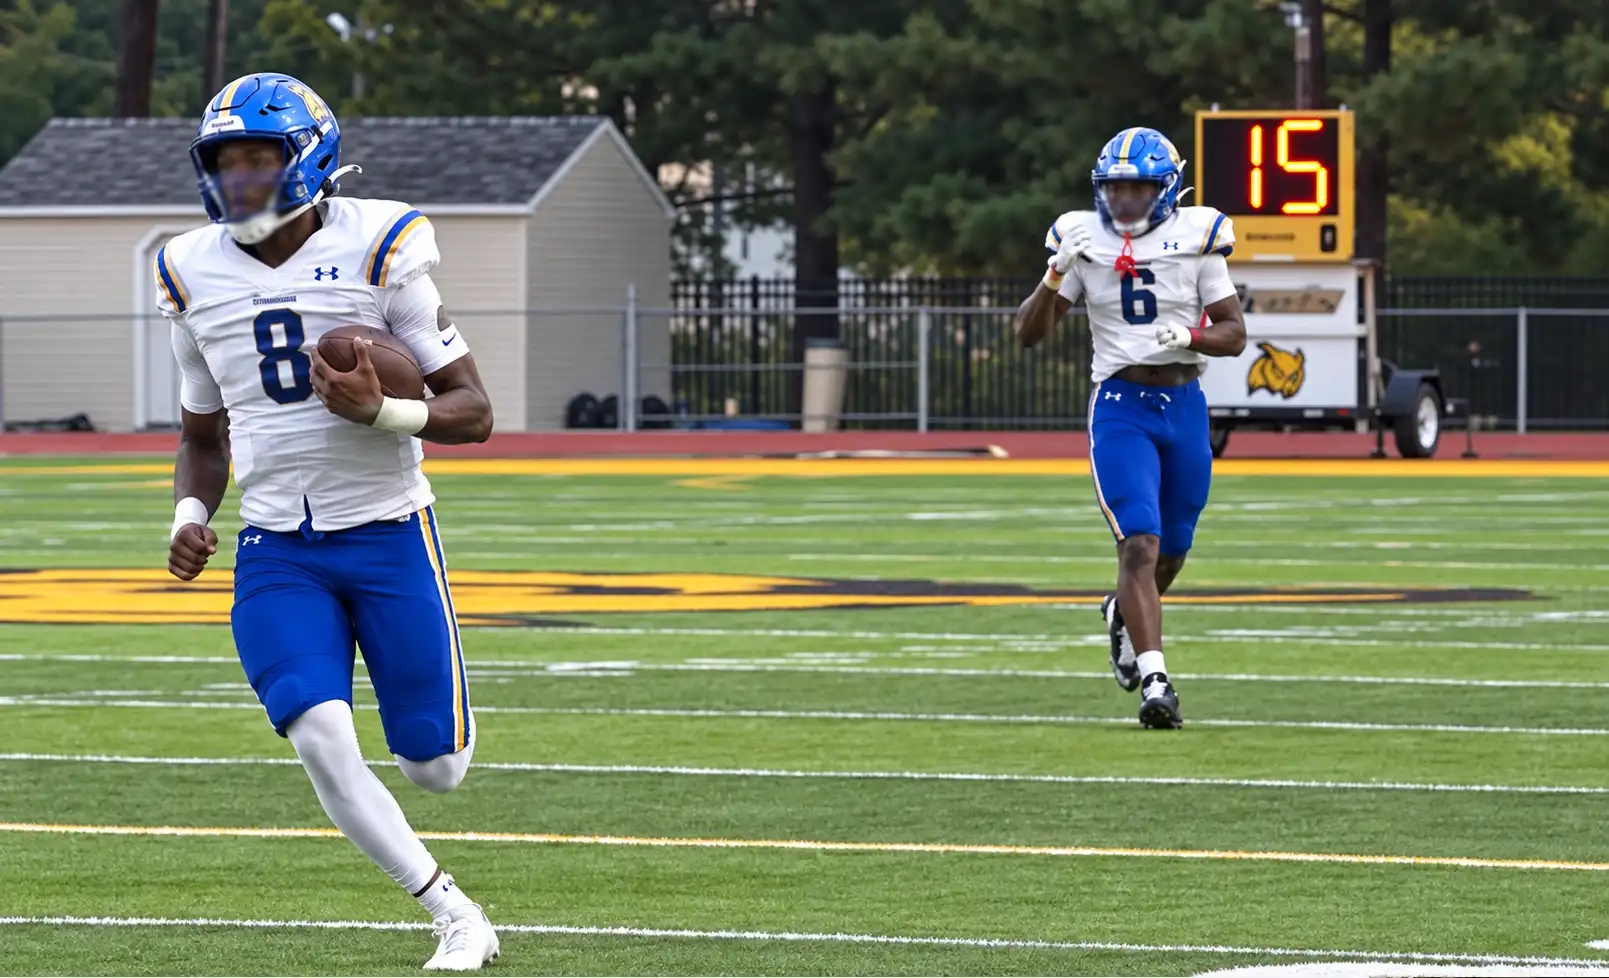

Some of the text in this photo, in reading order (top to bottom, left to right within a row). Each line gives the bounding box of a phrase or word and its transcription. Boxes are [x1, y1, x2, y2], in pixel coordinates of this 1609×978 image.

[1250, 118, 1328, 214] 15
[1120, 268, 1158, 325] 6
[253, 308, 314, 405] 8
